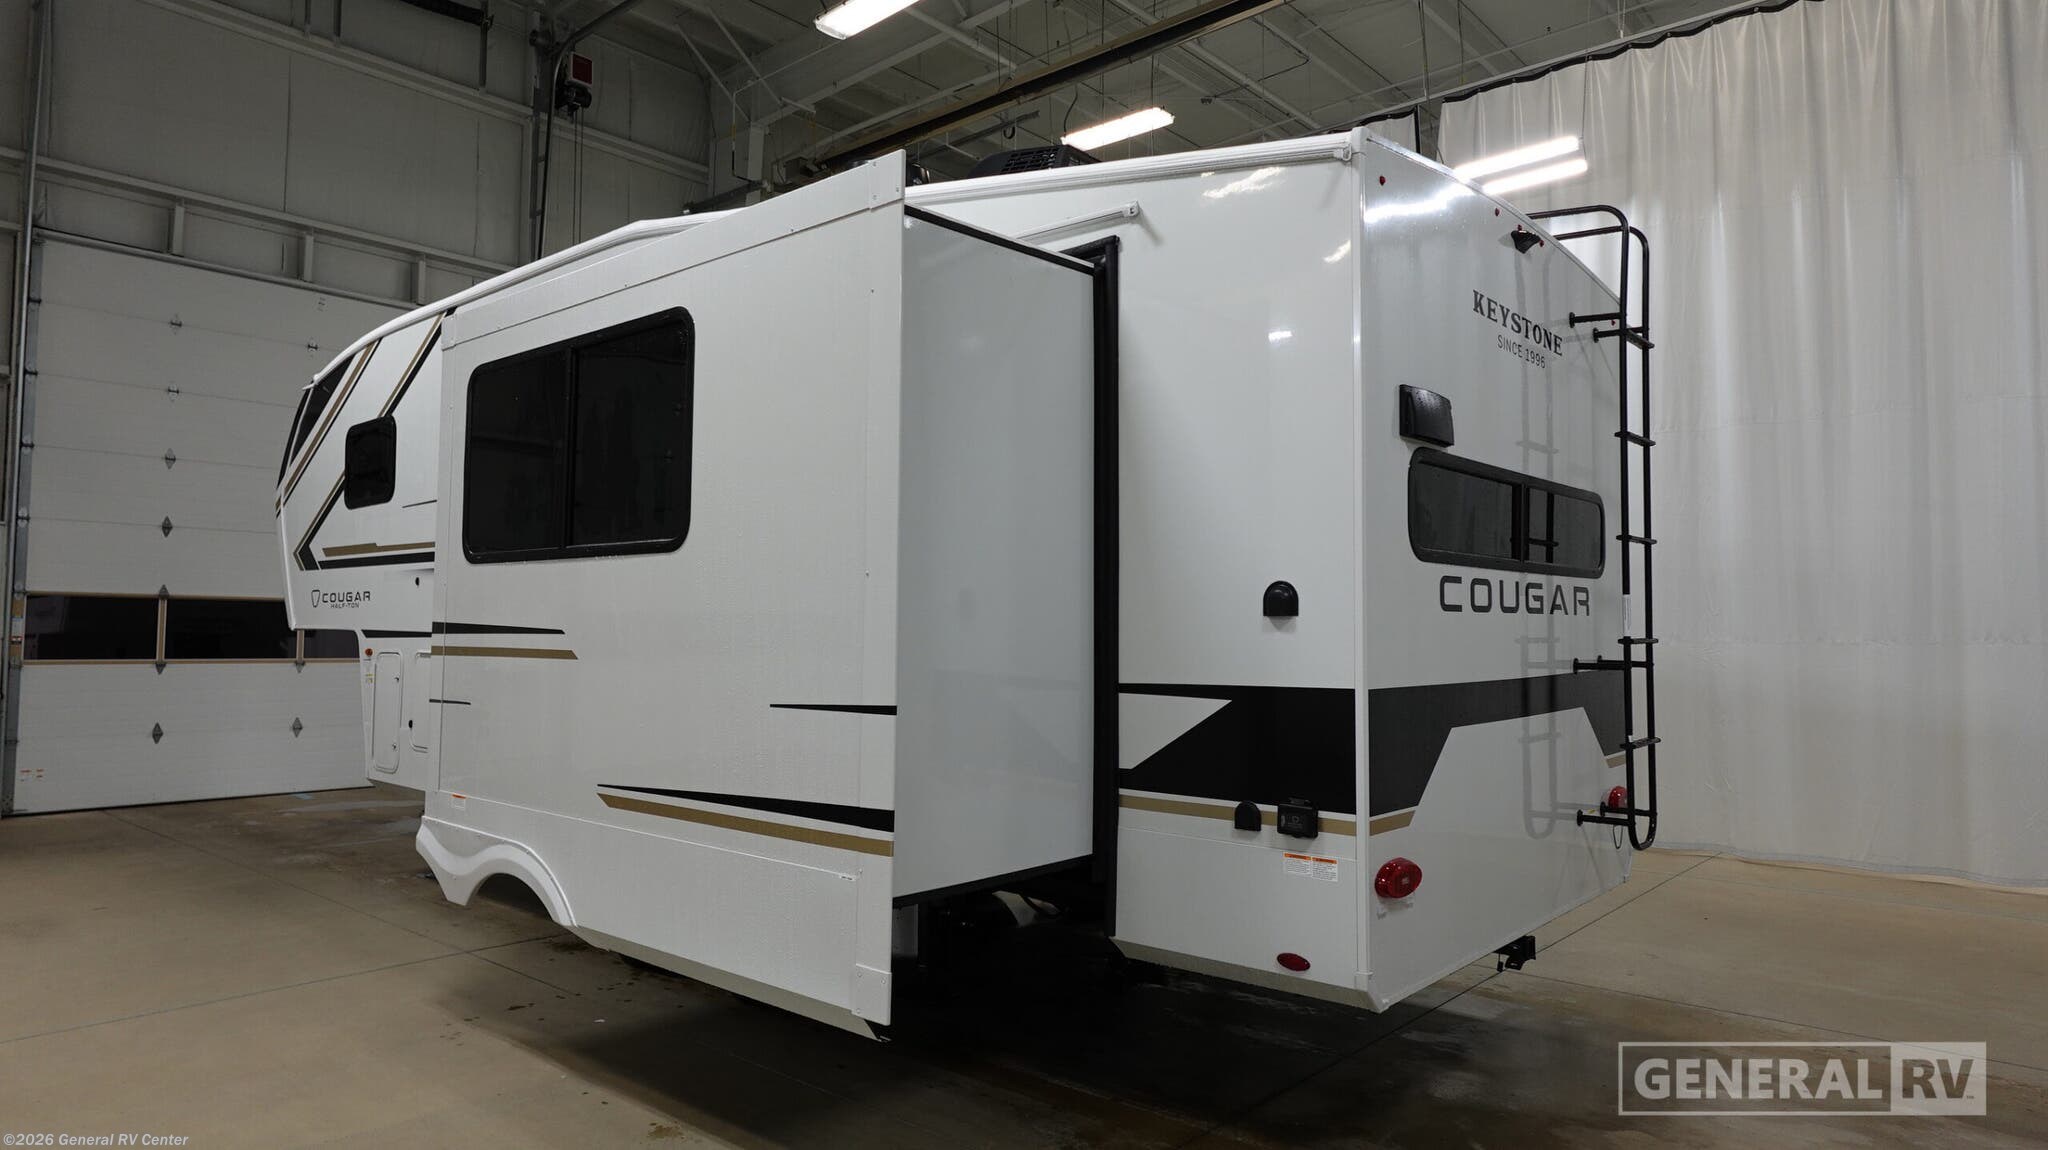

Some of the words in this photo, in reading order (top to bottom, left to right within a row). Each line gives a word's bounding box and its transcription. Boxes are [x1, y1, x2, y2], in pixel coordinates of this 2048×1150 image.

[1472, 289, 1563, 356] KEYSTONE
[1497, 334, 1523, 358] SINCE
[1525, 348, 1546, 369] 1996
[321, 591, 371, 603] COUGAR
[1439, 575, 1590, 617] COUGAR
